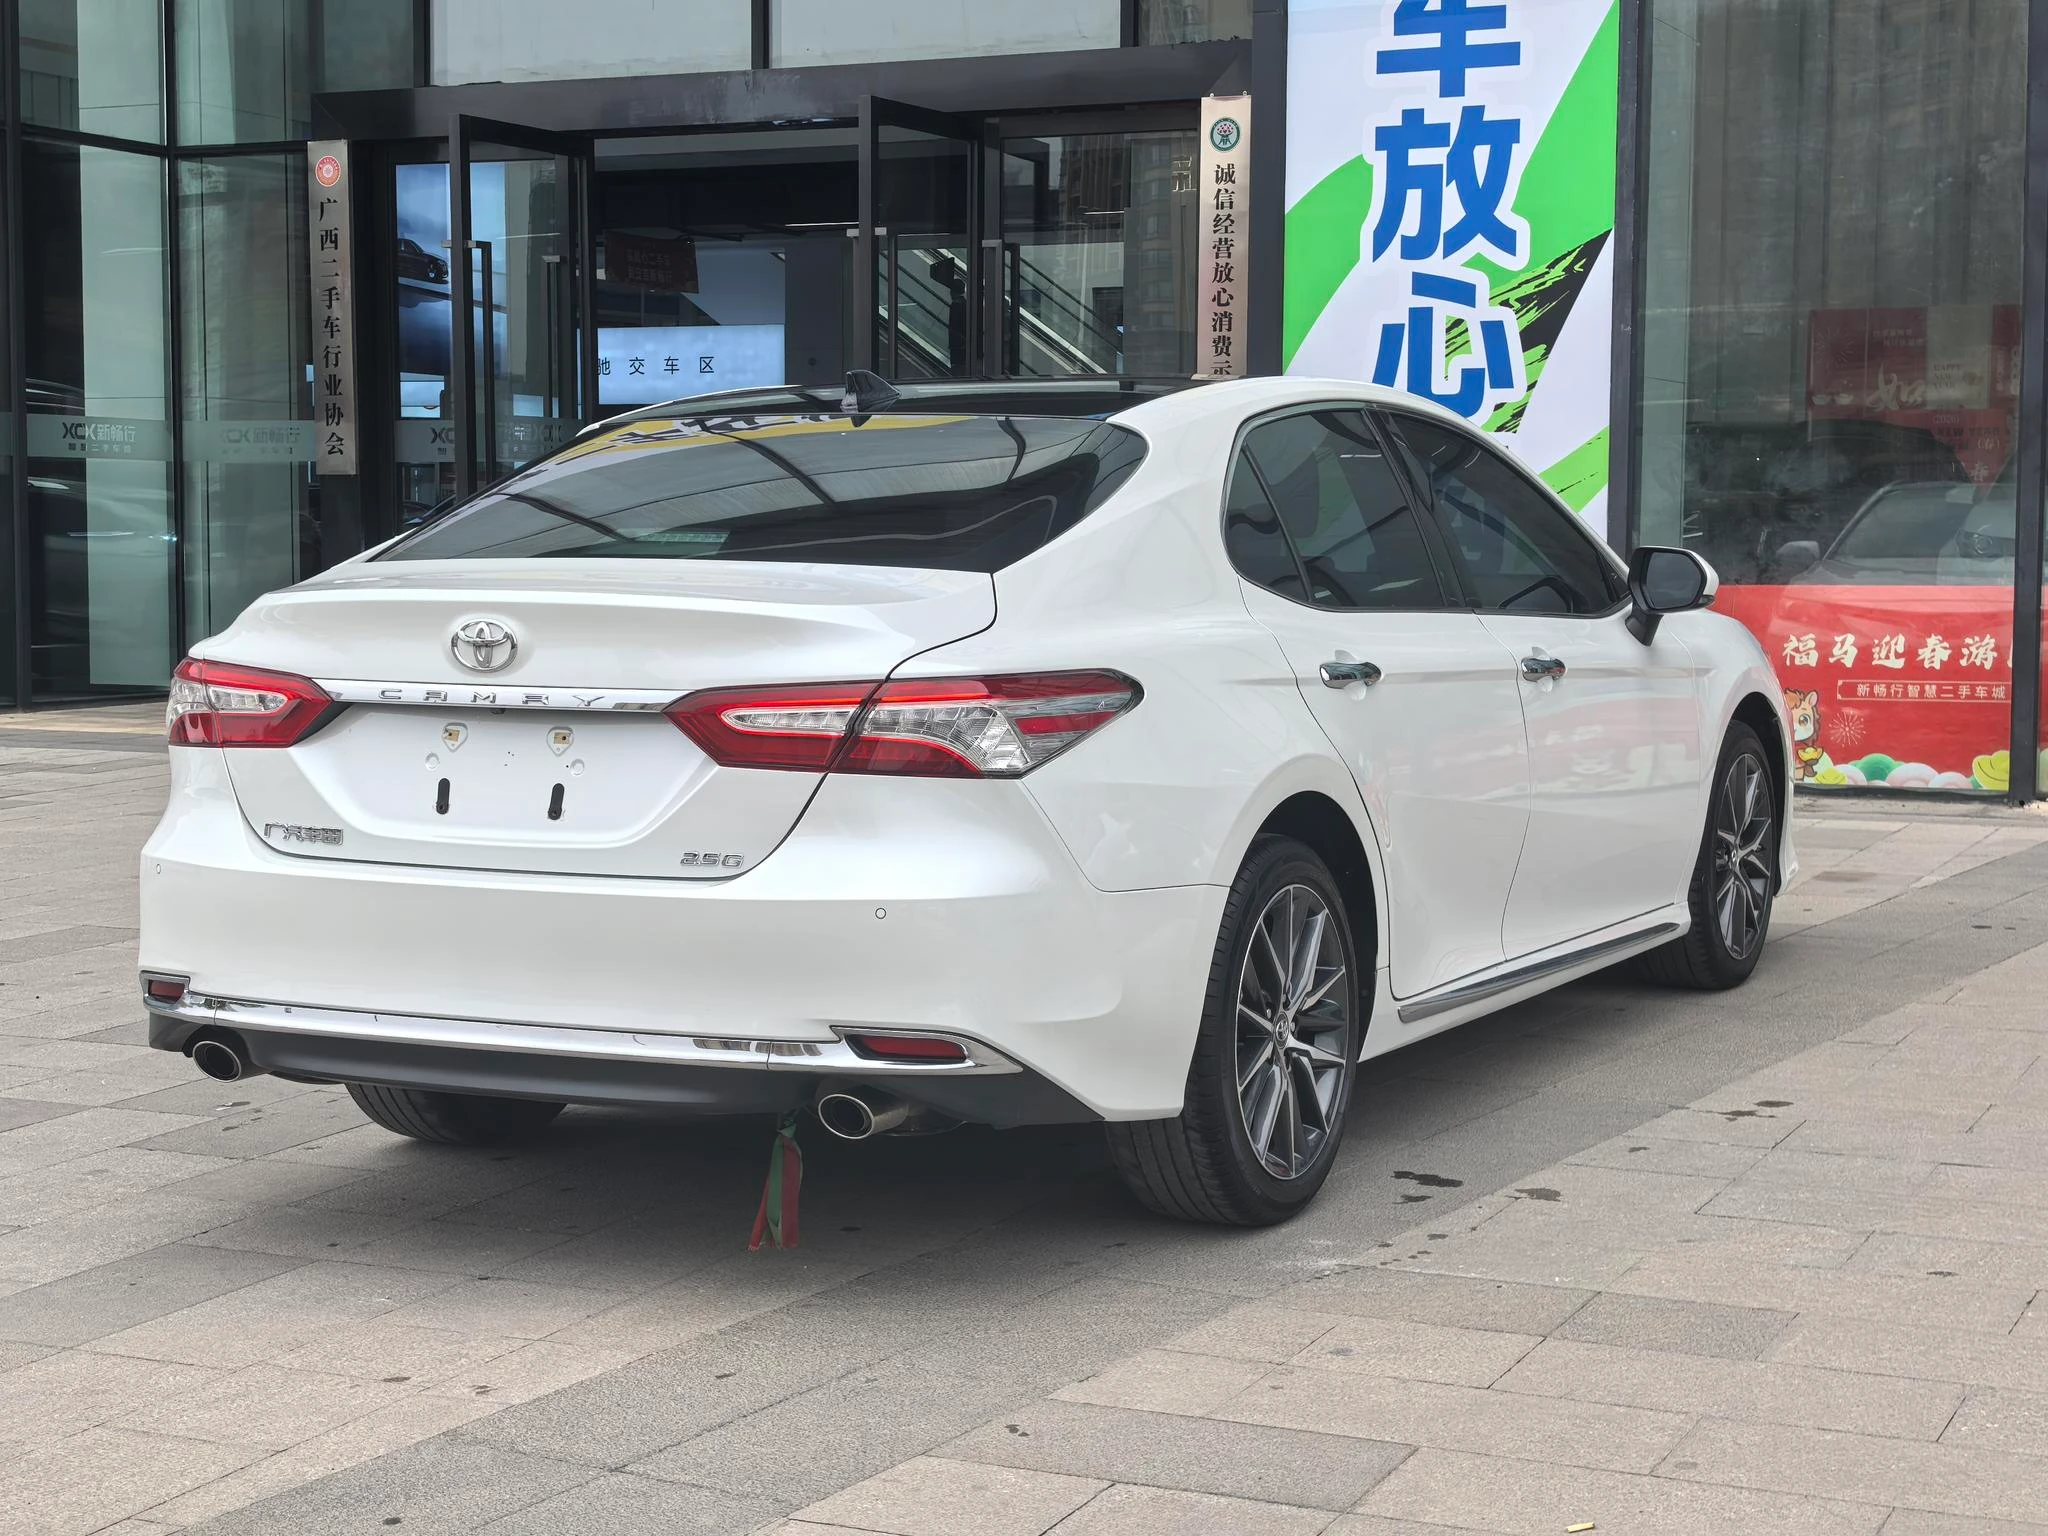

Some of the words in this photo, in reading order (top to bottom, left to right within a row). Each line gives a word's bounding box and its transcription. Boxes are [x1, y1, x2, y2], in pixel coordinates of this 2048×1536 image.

[1211, 163, 1236, 375] 诚信经营放心消费示
[1373, 0, 1521, 418] 车放心
[319, 197, 344, 457] 广西二手车行业协会
[378, 688, 605, 706] CAMRY
[1783, 633, 2012, 670] 福马迎春游
[1856, 682, 2006, 700] 新畅行智慧二手车城
